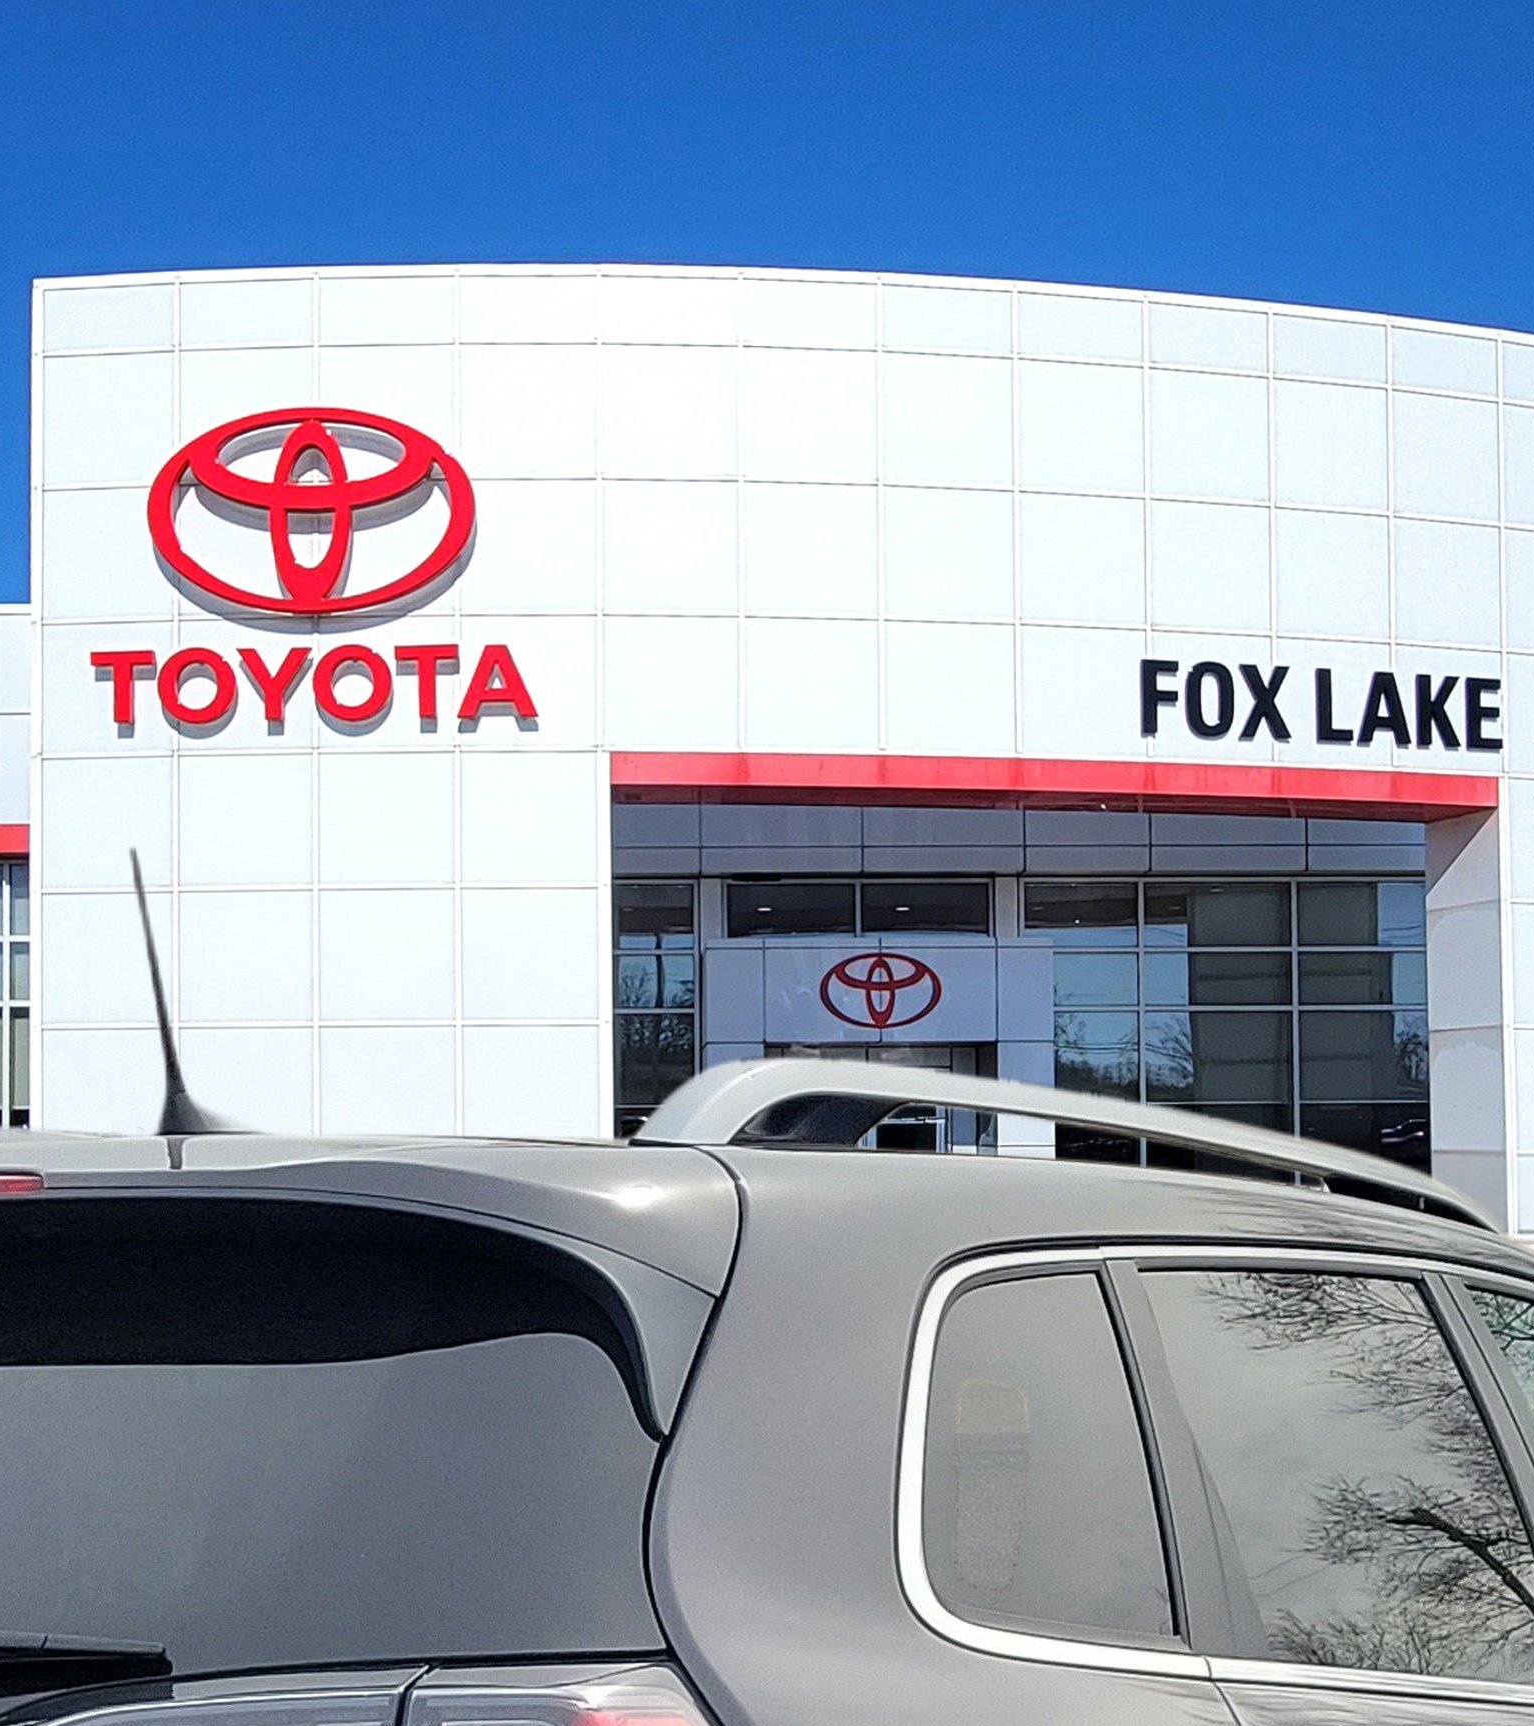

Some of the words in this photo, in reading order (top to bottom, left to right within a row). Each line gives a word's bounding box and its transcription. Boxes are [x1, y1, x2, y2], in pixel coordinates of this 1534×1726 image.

[90, 643, 539, 725] TOYOTA
[1140, 658, 1291, 742] FOX
[1314, 667, 1503, 751] LAKE
